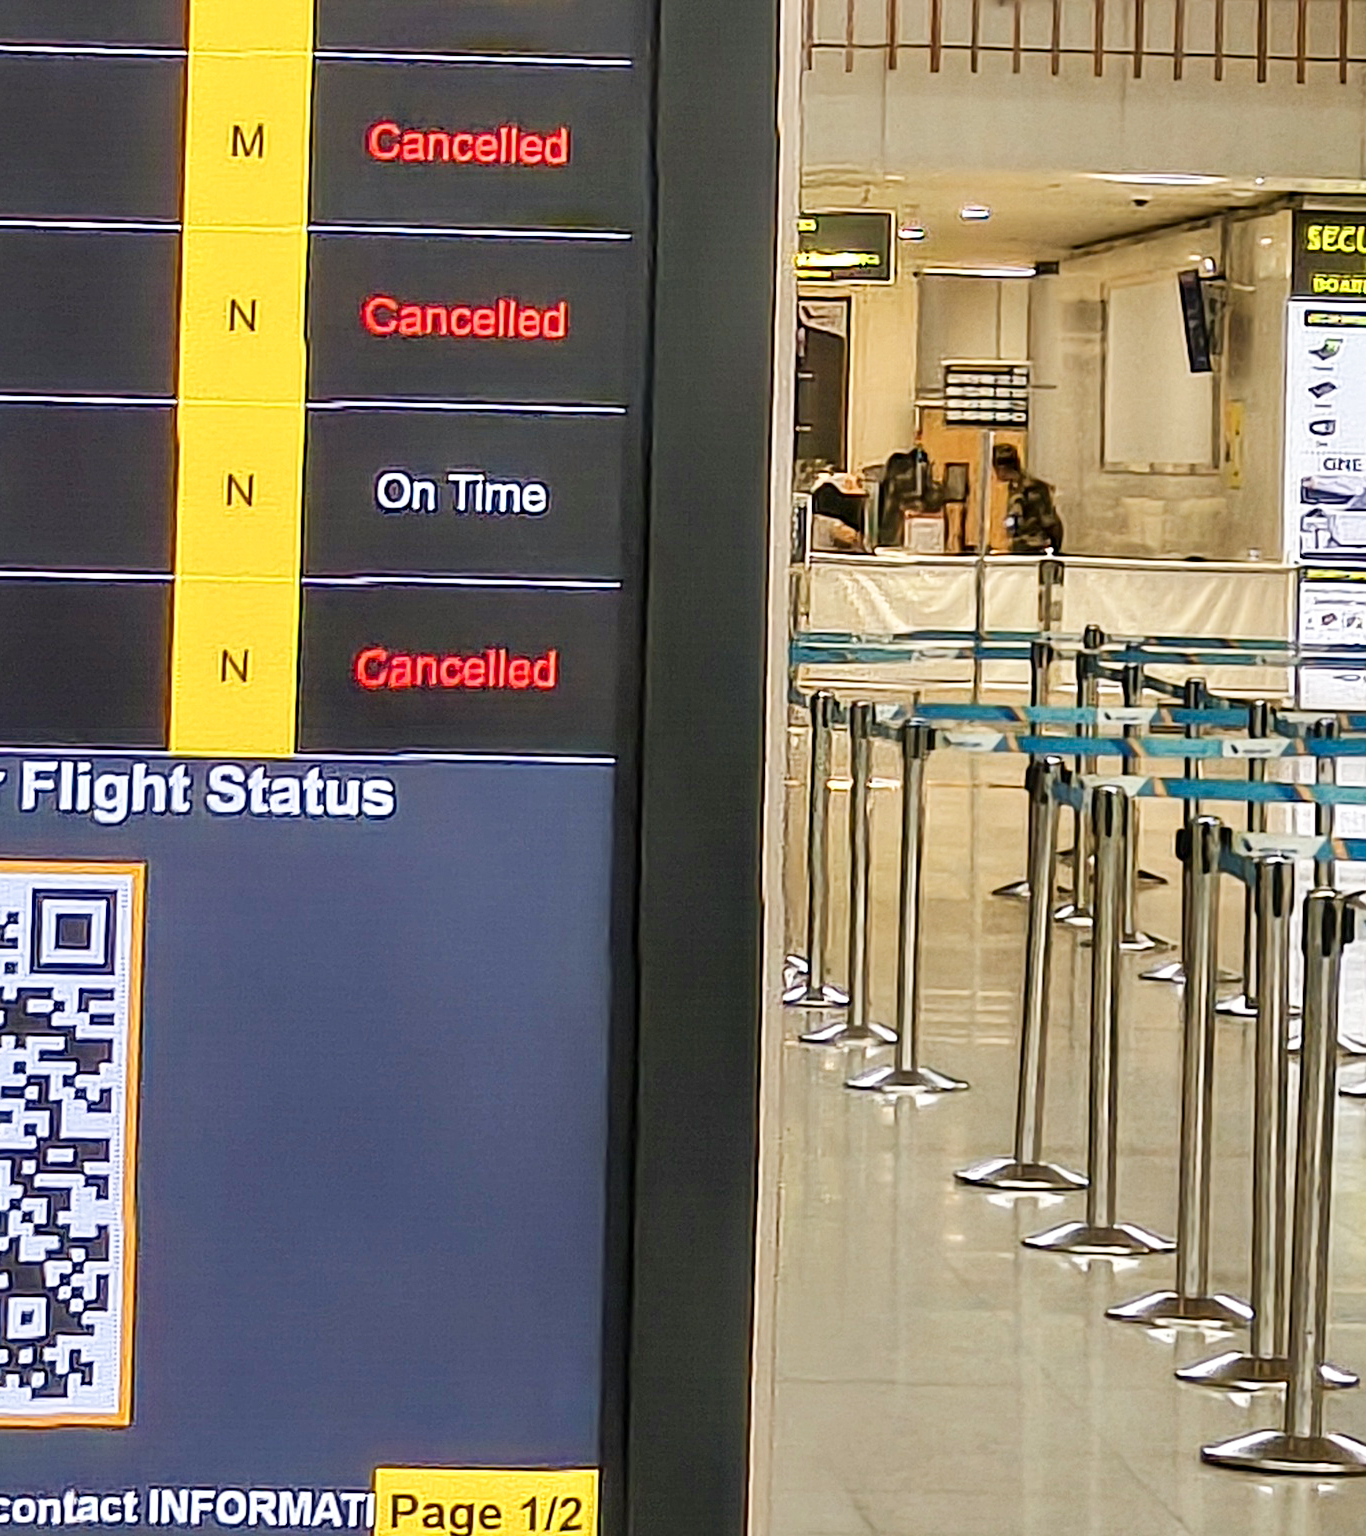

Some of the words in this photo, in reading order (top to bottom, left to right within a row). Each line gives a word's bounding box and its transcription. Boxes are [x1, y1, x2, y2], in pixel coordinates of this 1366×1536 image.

[231, 123, 264, 159] M
[364, 119, 571, 168] Cancelled
[228, 298, 257, 332] N
[363, 293, 570, 341] Cancelled
[226, 473, 254, 507] N
[377, 472, 436, 511] On
[447, 473, 547, 513] Time
[220, 649, 249, 683] N
[352, 647, 559, 691] Cancelled
[21, 761, 192, 825] Flight
[206, 764, 397, 817] Status
[390, 1493, 502, 1536] Page
[520, 1496, 583, 1533] 1/2
